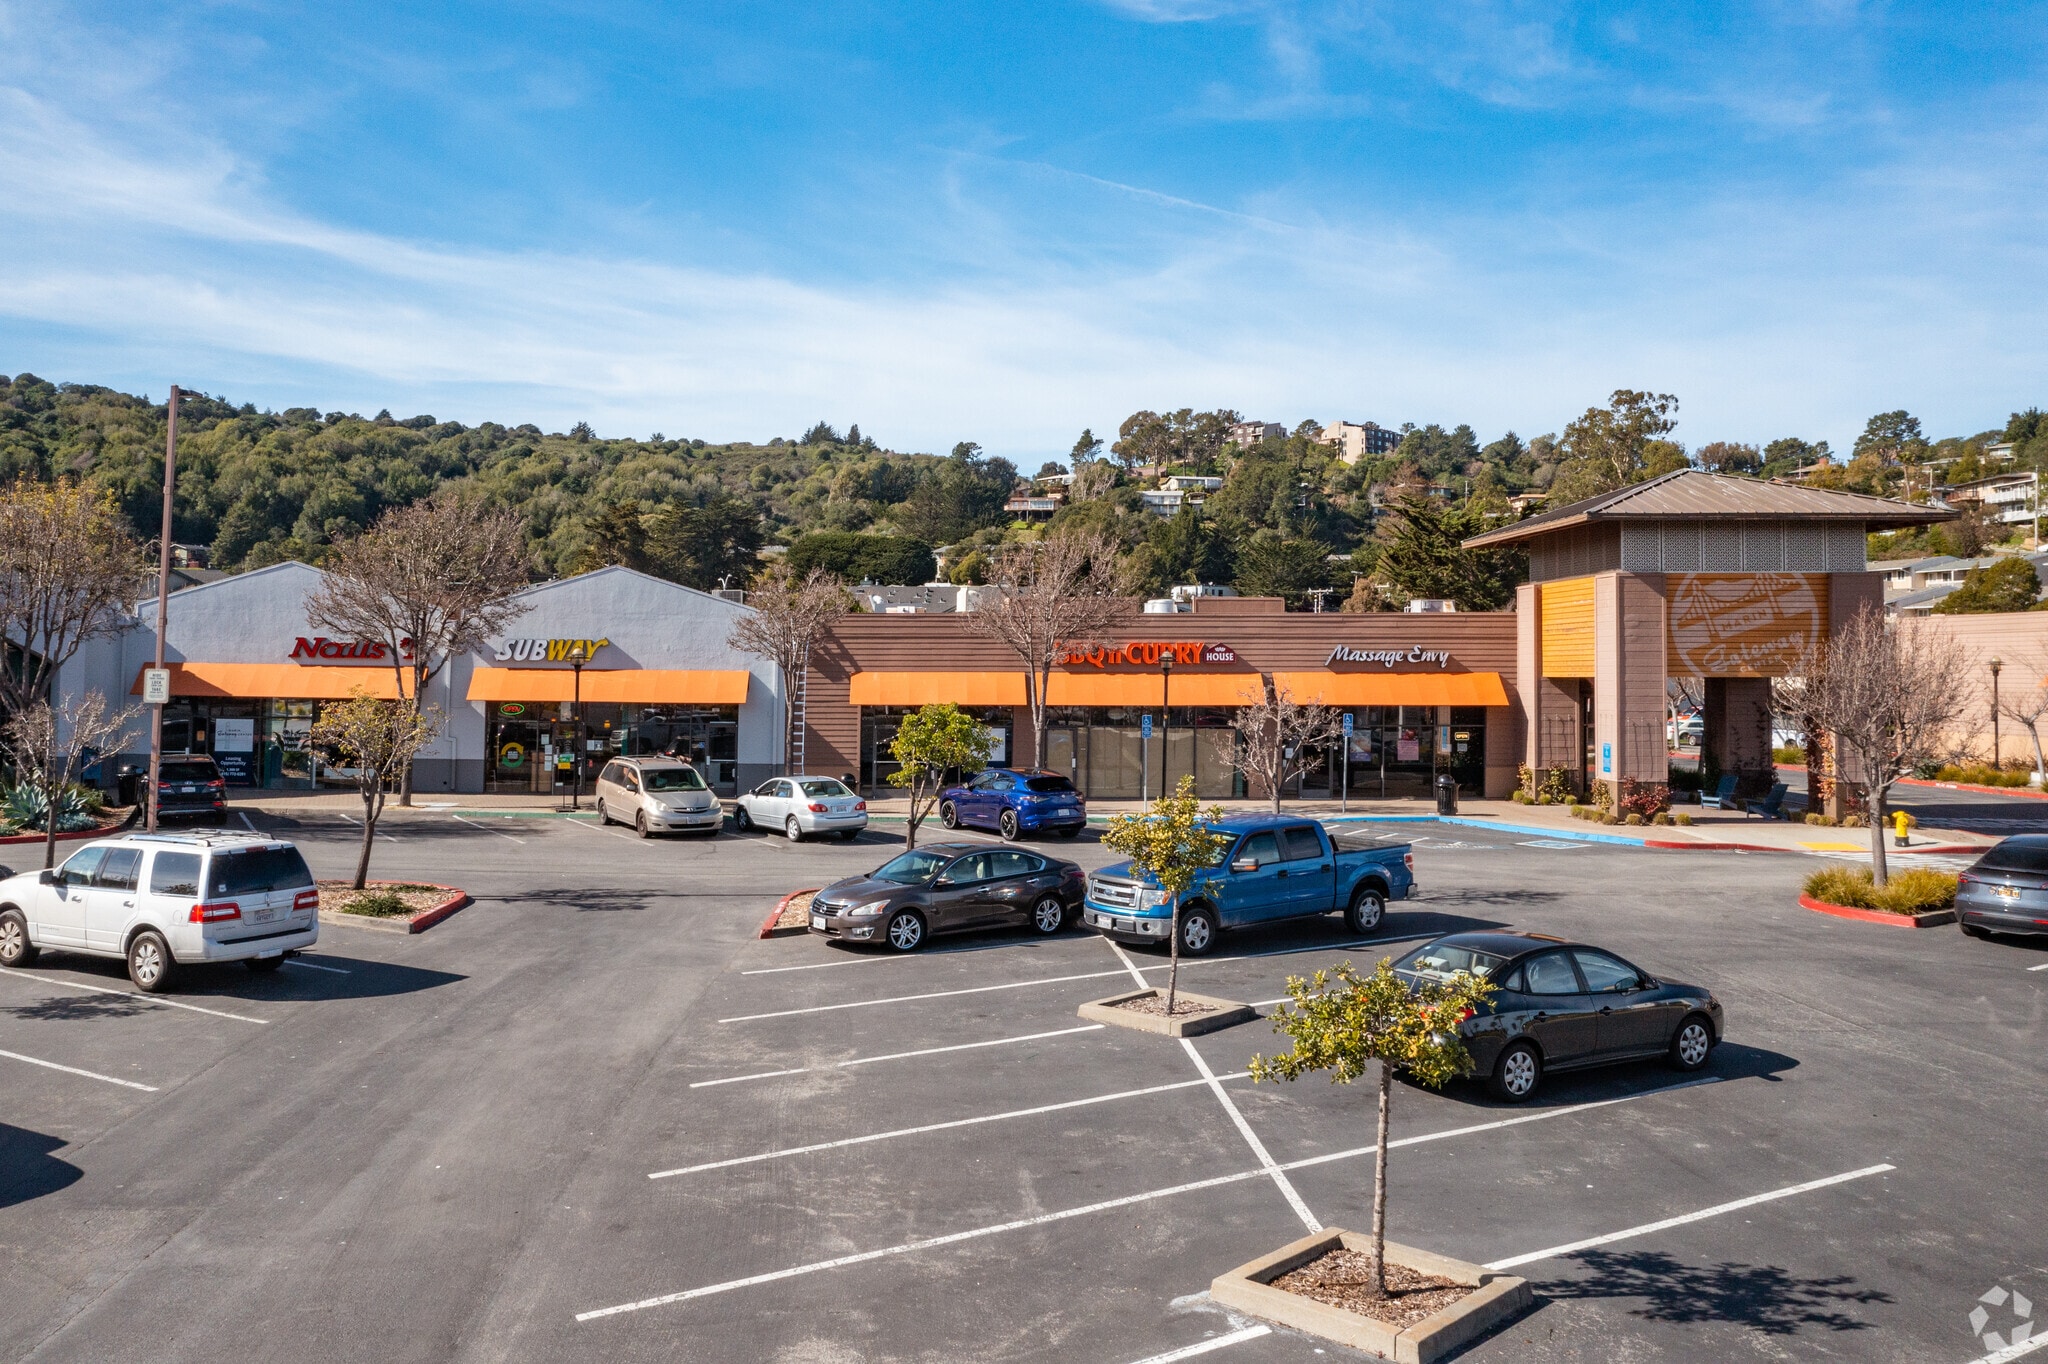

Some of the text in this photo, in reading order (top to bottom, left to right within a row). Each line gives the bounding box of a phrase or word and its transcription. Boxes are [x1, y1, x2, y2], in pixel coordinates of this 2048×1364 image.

[1722, 608, 1768, 631] MARIN
[288, 637, 386, 659] Nails
[494, 637, 609, 661] SUBWAY
[1126, 642, 1204, 665] CURRY
[1206, 652, 1234, 662] HOUSE
[1324, 644, 1449, 668] Massage Envy
